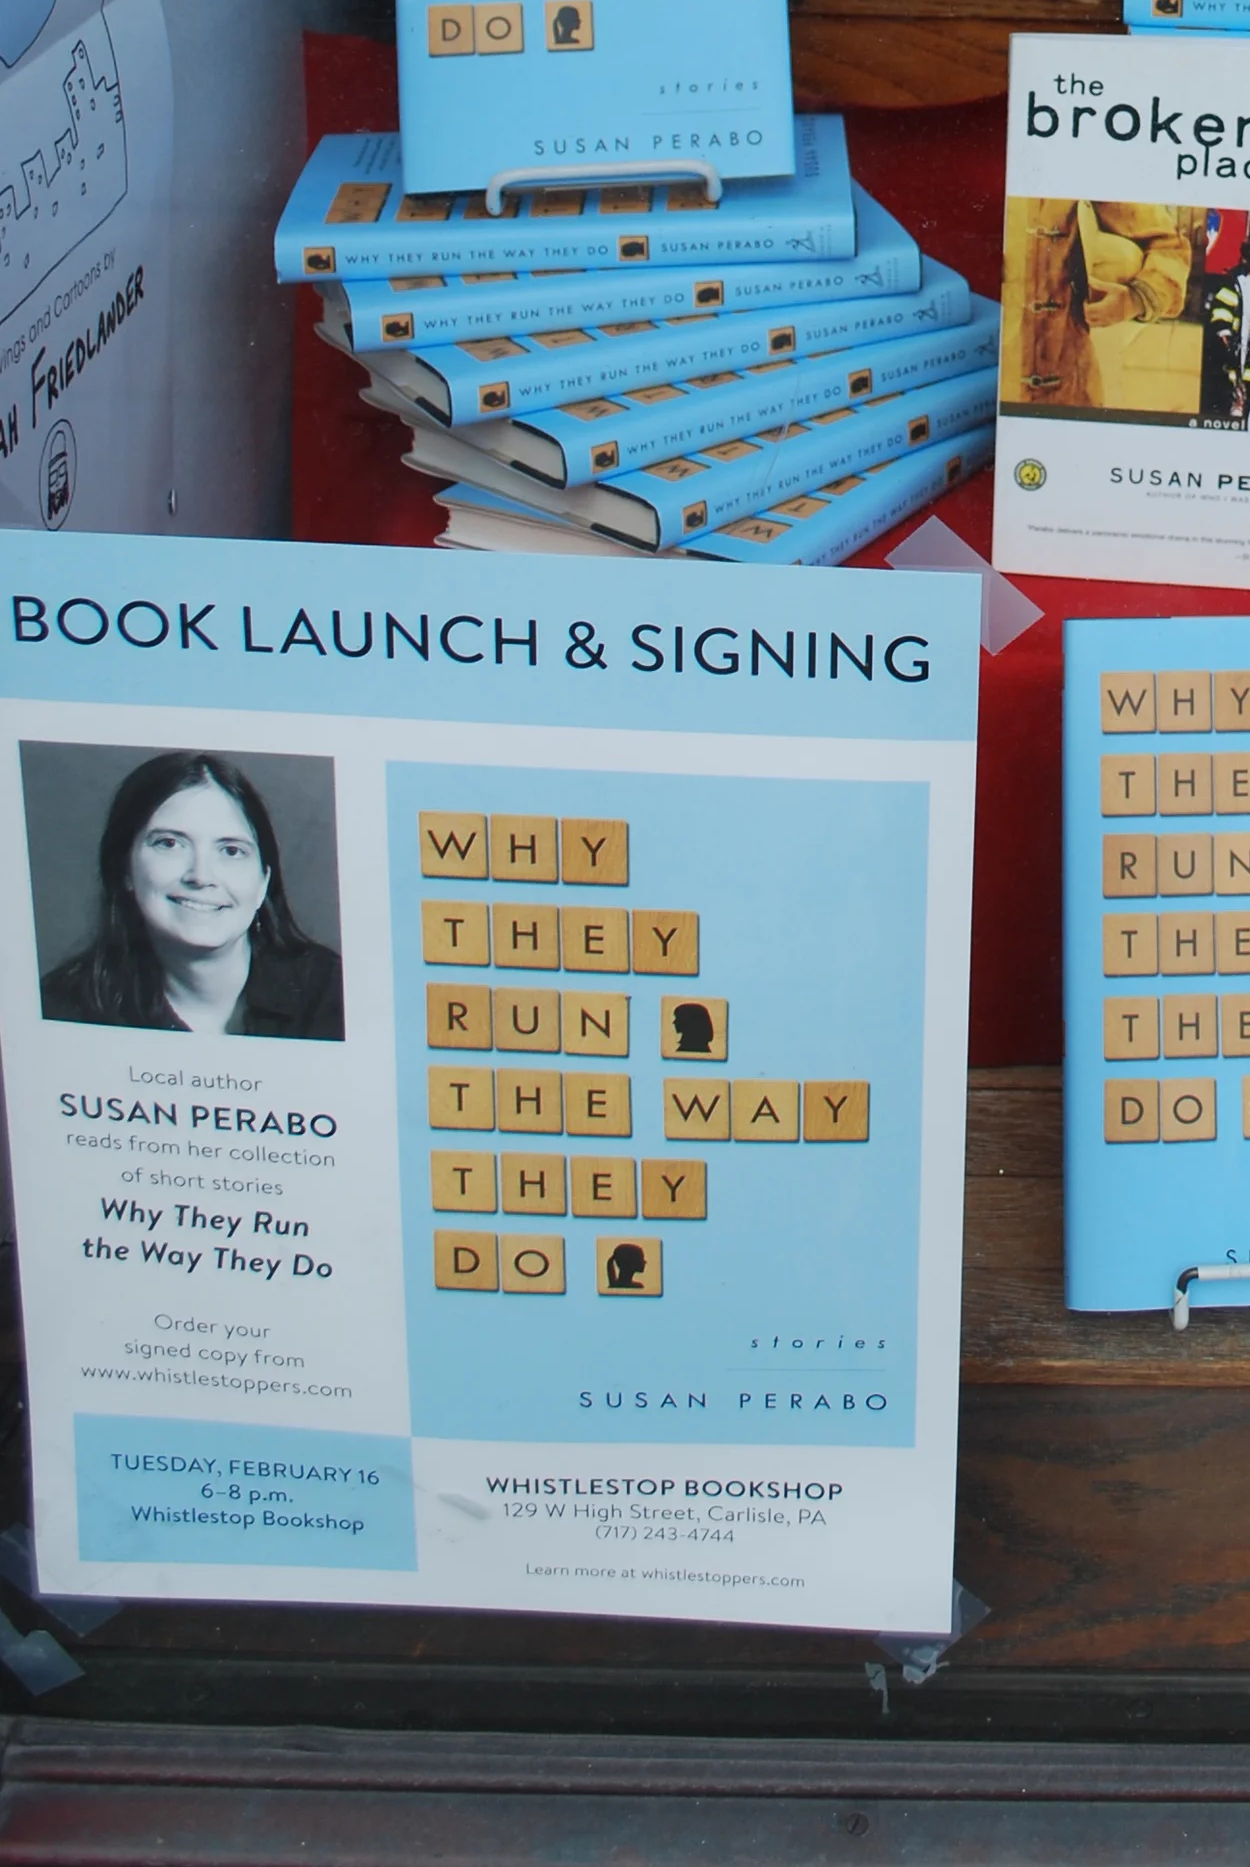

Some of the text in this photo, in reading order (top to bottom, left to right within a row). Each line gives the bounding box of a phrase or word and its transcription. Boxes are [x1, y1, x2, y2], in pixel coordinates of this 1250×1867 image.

[1054, 74, 1104, 96] the
[29, 247, 117, 343] and Cartoons by
[31, 265, 144, 429] FRIEDLANDER
[1189, 419, 1246, 430] a novel
[1110, 468, 1201, 487] SUSAN
[12, 593, 931, 683] BOOK LAUNCH & SIGNING
[423, 824, 610, 872] WHY
[439, 913, 681, 962] THEY
[443, 996, 615, 1043] RUN
[129, 1065, 263, 1092] Local author
[59, 1093, 338, 1138] SUSAN PERABO
[446, 1078, 851, 1128] THE WAY
[67, 1133, 335, 1167] reads from her collection
[121, 1168, 283, 1196] of short stories
[448, 1162, 689, 1208] THEY
[101, 1197, 309, 1238] Why They Run
[83, 1237, 333, 1280] the Way They Do
[449, 1240, 555, 1284] DO
[154, 1313, 270, 1339] Order your
[125, 1339, 305, 1368] signed copy from
[751, 1335, 886, 1350] stories
[81, 1365, 352, 1398] www.whistlestoppers.com
[579, 1391, 888, 1411] SUSAN PERABO
[111, 1453, 379, 1485] TUESDAY, FEBRUARY 16
[249, 1488, 293, 1505] p.m.
[486, 1477, 843, 1500] WHISTLESTOP BOOKSHOP
[131, 1505, 365, 1534] Whistlestop Bookshop
[503, 1503, 827, 1527] 129 W High Street, Carlisle, PA
[595, 1525, 735, 1543] (717) 243-4744
[526, 1563, 805, 1588] Learn more at whistlestoppers.com
